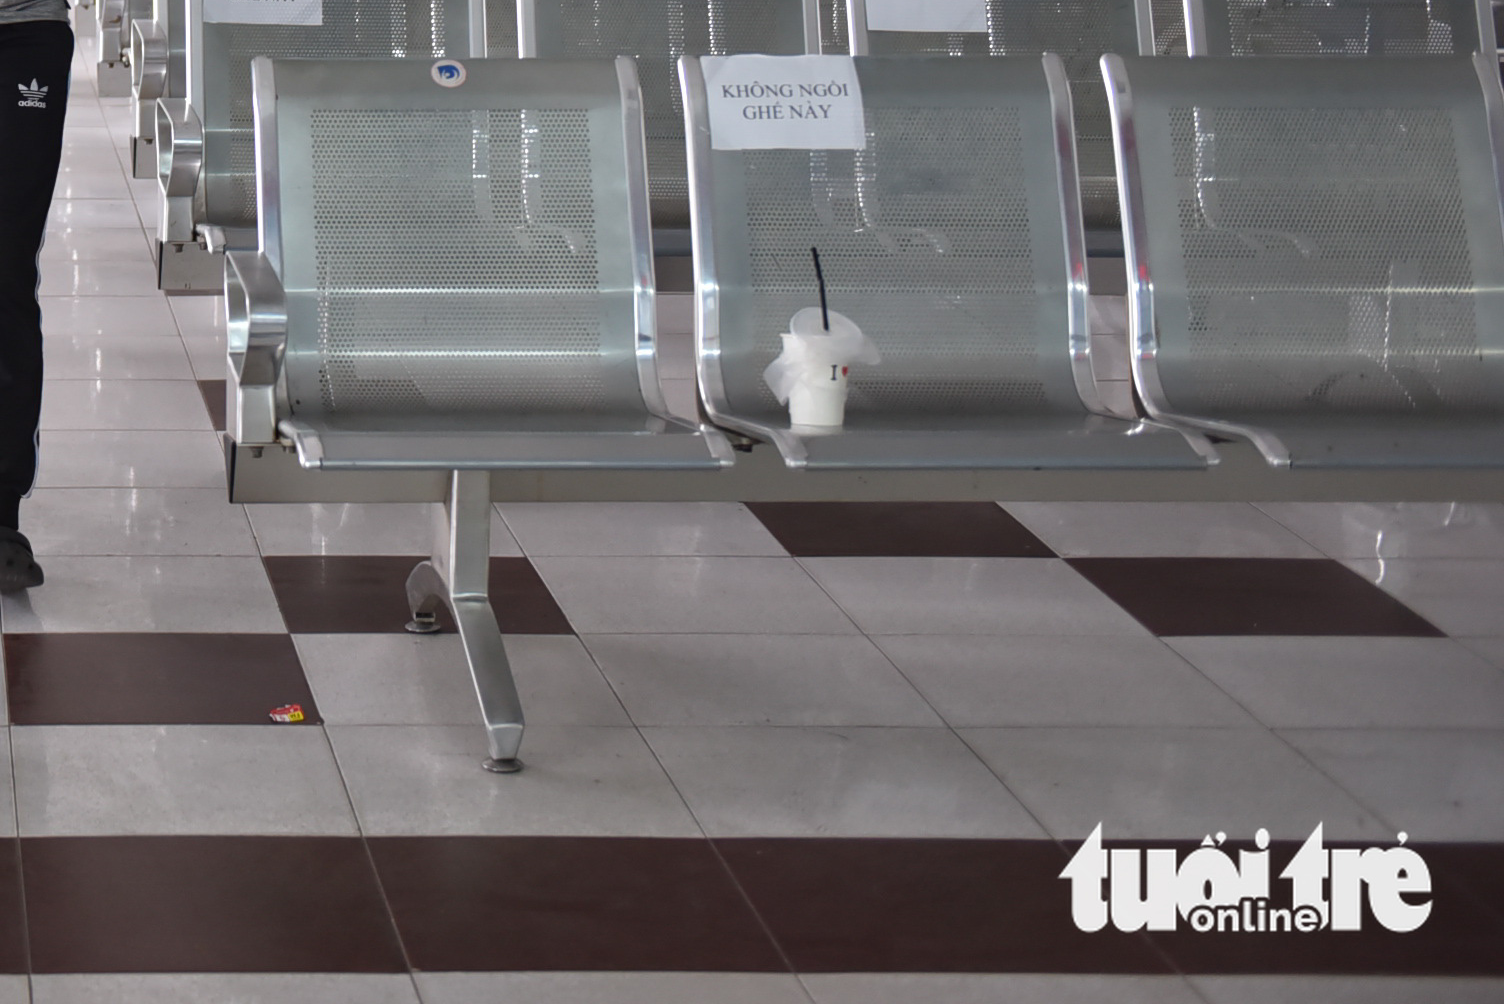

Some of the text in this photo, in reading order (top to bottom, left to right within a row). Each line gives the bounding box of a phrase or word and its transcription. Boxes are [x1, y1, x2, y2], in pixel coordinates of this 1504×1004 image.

[721, 81, 793, 98] KHÔNG
[17, 100, 47, 109] adidas
[788, 100, 832, 119] NÀY
